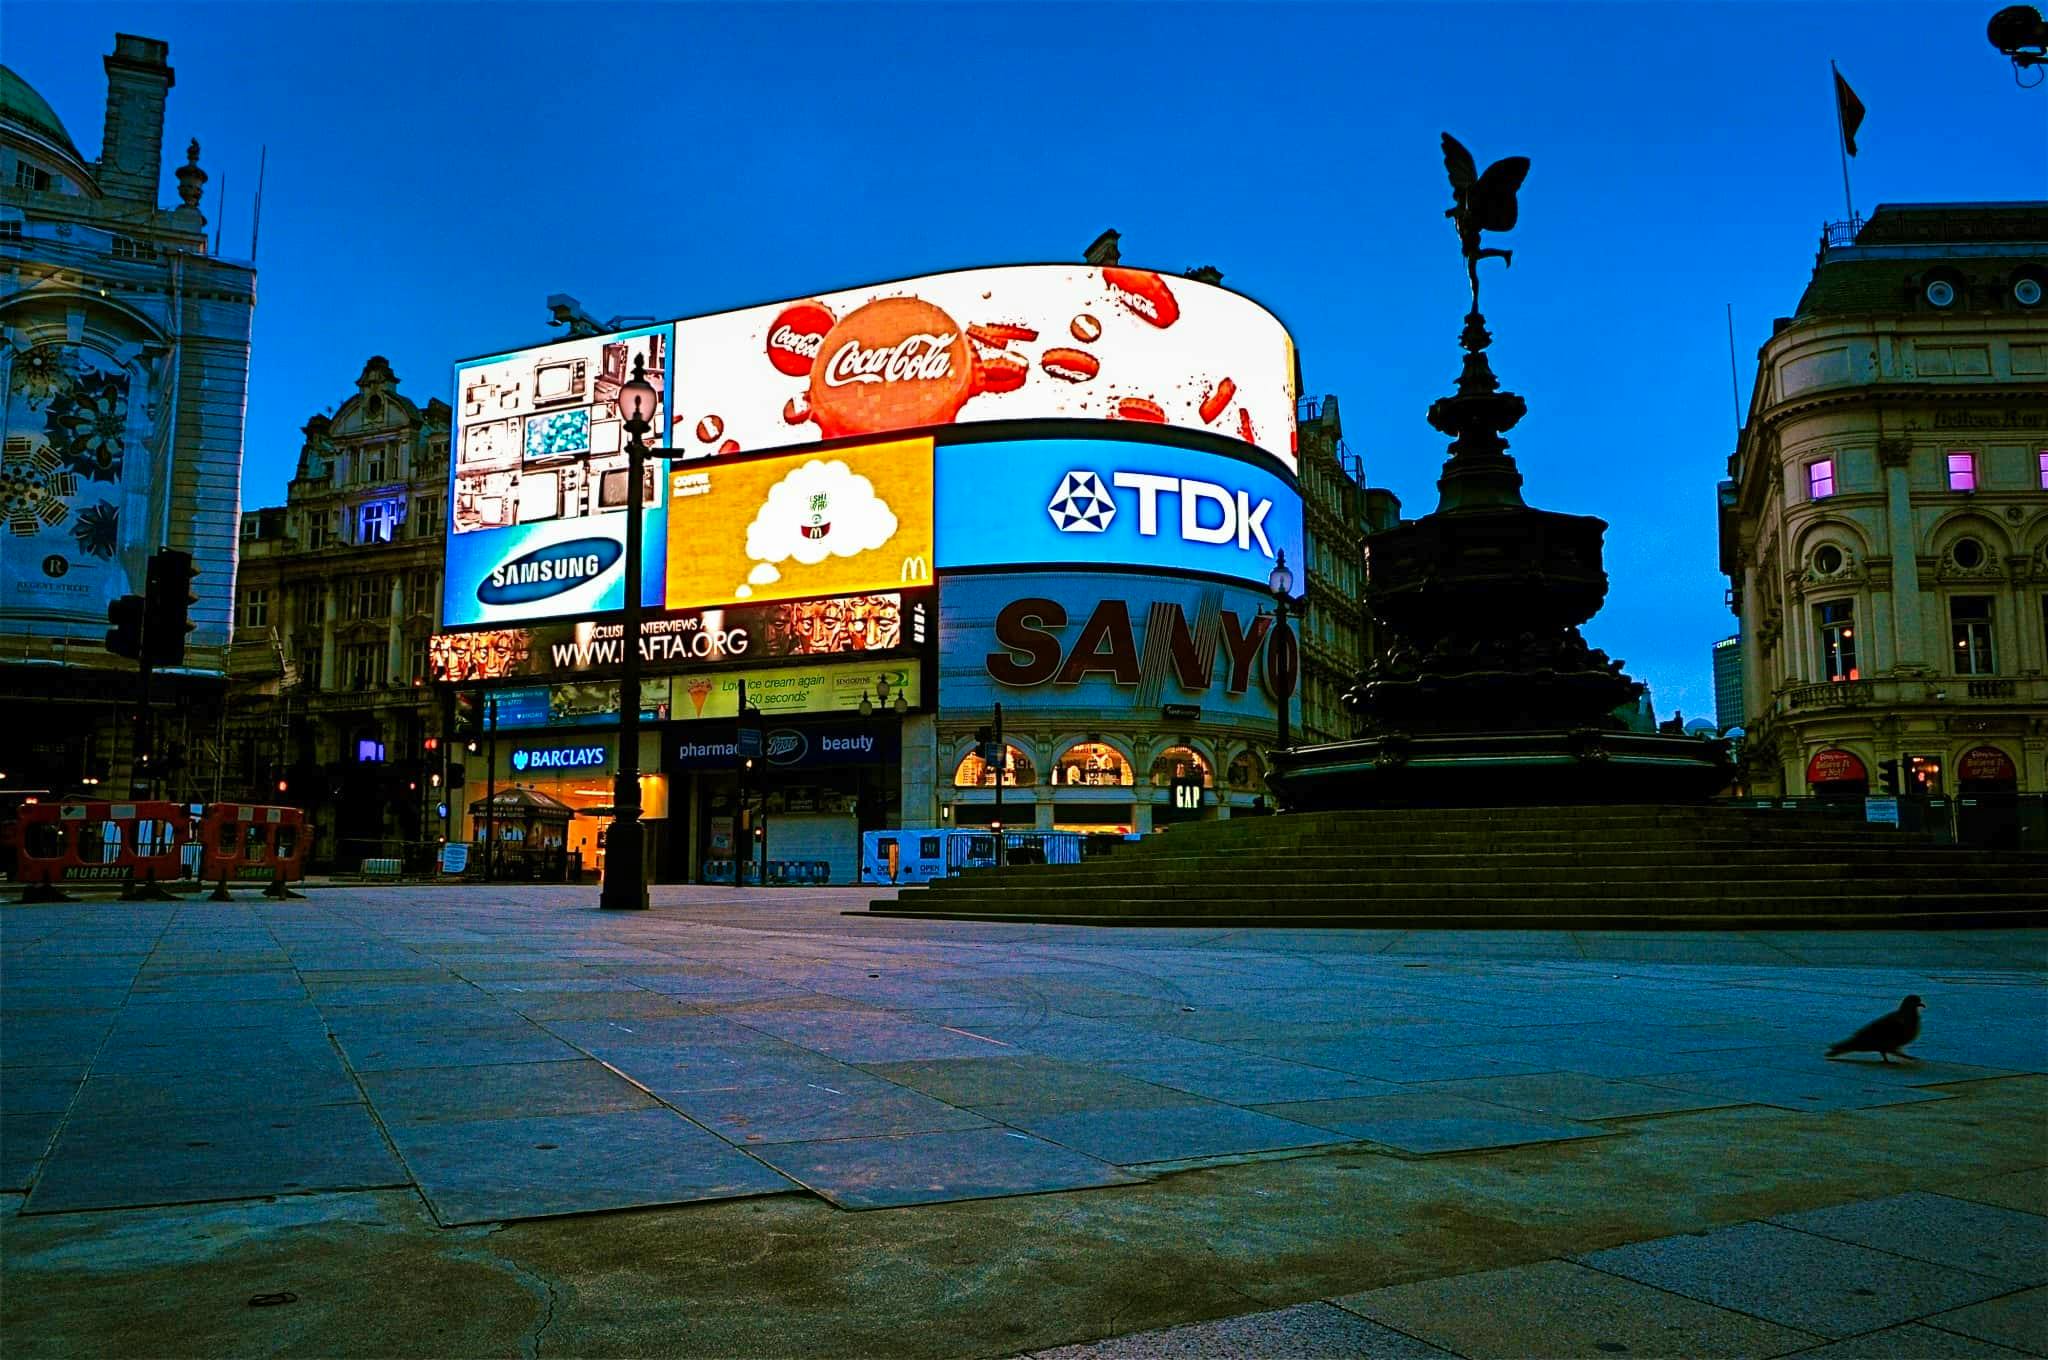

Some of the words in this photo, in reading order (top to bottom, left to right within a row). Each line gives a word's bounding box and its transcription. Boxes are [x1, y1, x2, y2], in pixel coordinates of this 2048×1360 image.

[825, 333, 958, 387] Coca-Cola
[1113, 471, 1274, 559] TDK
[492, 554, 599, 588] SAMSUNG
[640, 618, 698, 635] NTERVIEWS
[551, 629, 749, 668] WWW.AFTA.ORG
[984, 590, 1300, 704] SANYO
[764, 678, 795, 689] cream
[797, 675, 825, 690] again
[822, 734, 874, 753] beauty
[530, 747, 604, 767] BARCLAYS
[1176, 785, 1200, 809] GAP
[66, 867, 131, 880] MURPHY
